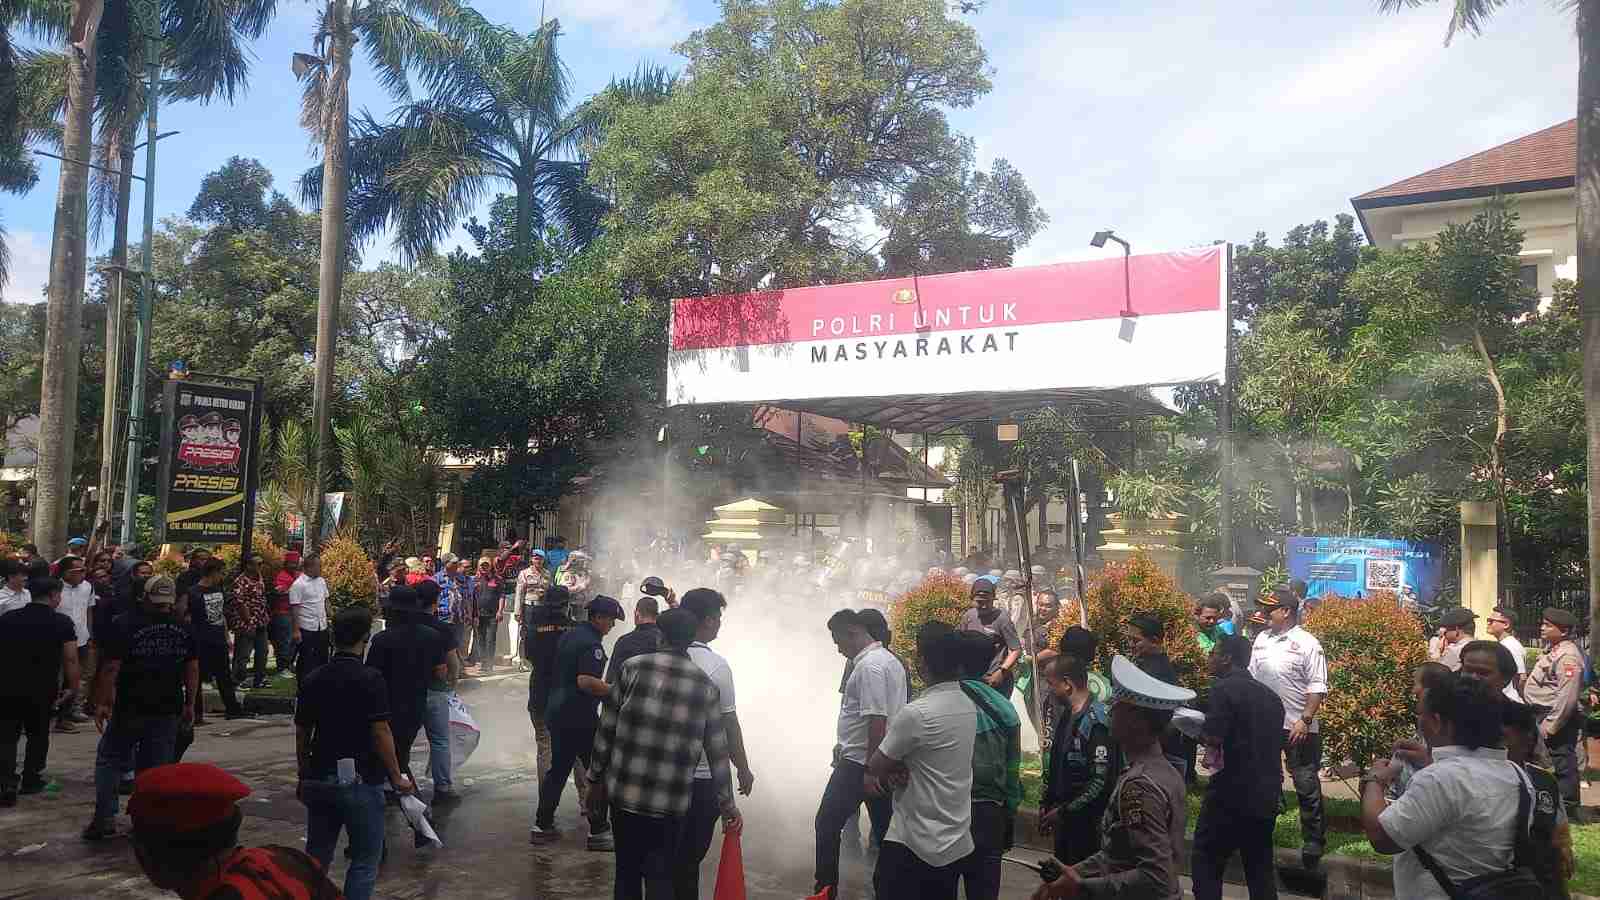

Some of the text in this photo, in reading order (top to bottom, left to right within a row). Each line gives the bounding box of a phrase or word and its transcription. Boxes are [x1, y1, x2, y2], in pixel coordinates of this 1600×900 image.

[812, 303, 1017, 336] POLRI UNTUK
[811, 331, 1019, 363] MASYARAKAT
[174, 474, 239, 489] PRESISI
